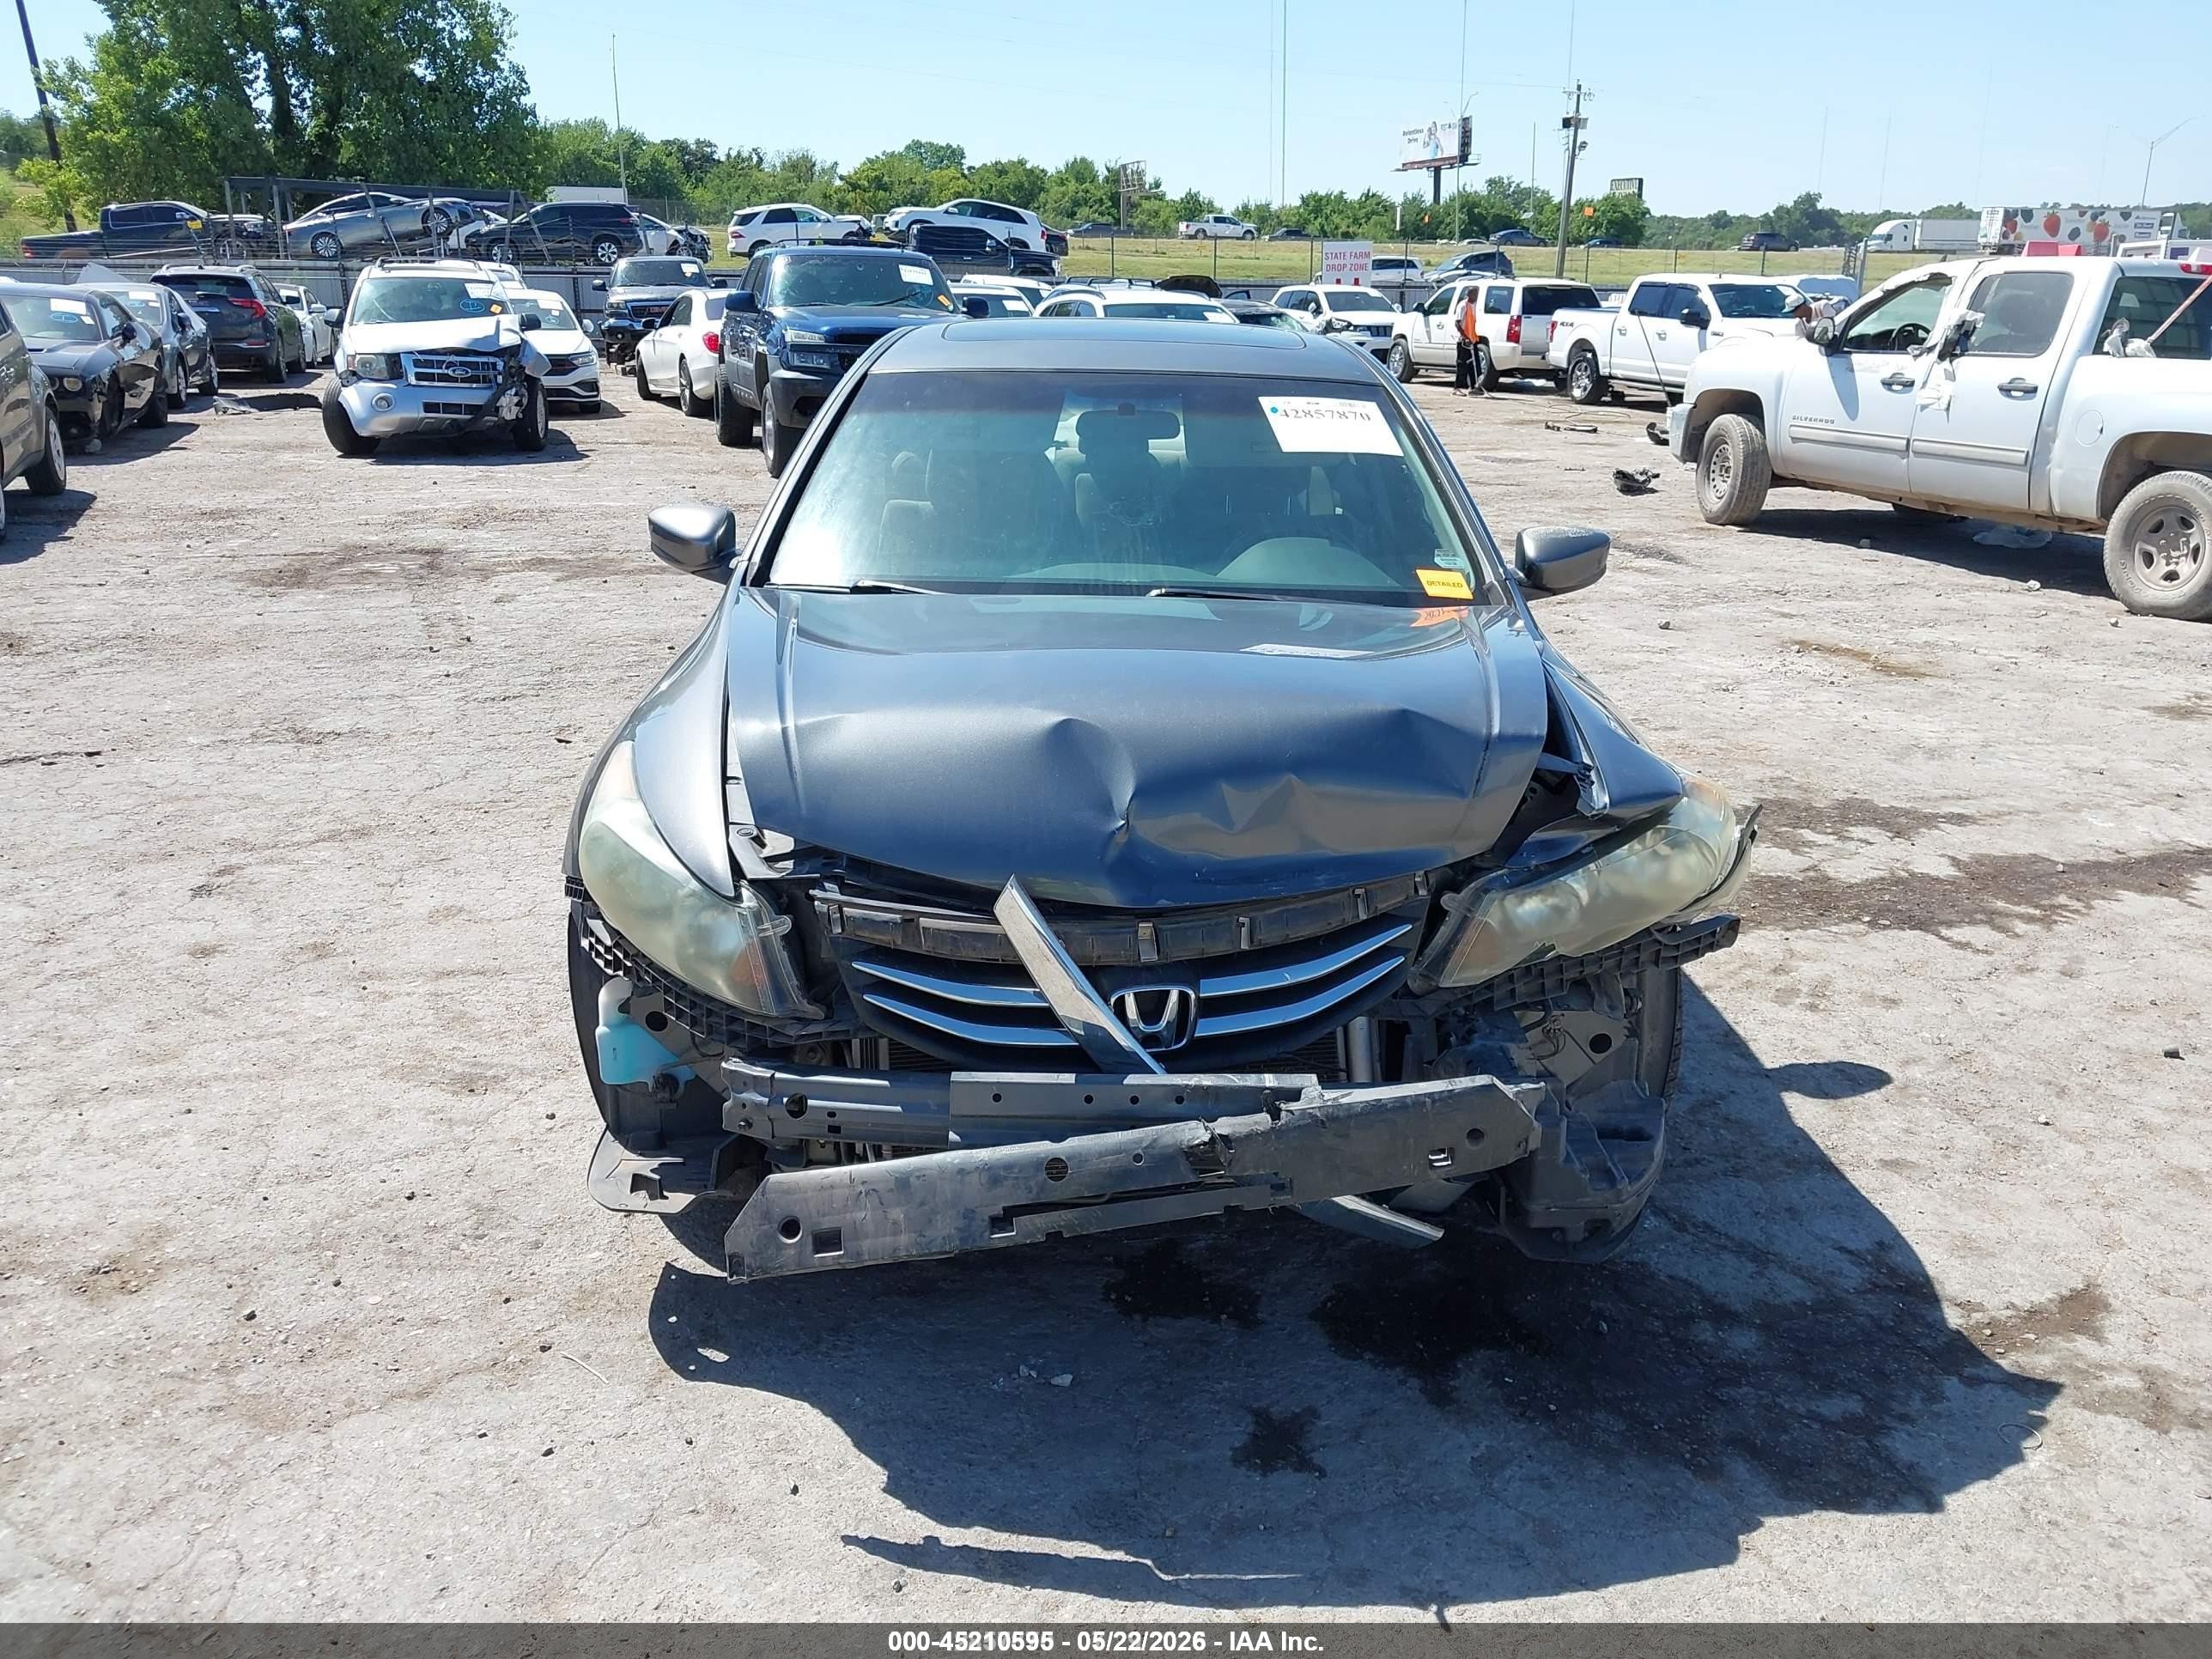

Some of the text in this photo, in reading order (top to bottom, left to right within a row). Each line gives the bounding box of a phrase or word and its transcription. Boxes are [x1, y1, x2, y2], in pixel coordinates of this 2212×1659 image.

[1325, 251, 1371, 261] STATE FARM
[1326, 263, 1369, 272] DROP ZONE
[1279, 408, 1371, 422] 42857870
[1792, 414, 1835, 425] SILVERADO
[1426, 580, 1464, 589] DETAILED
